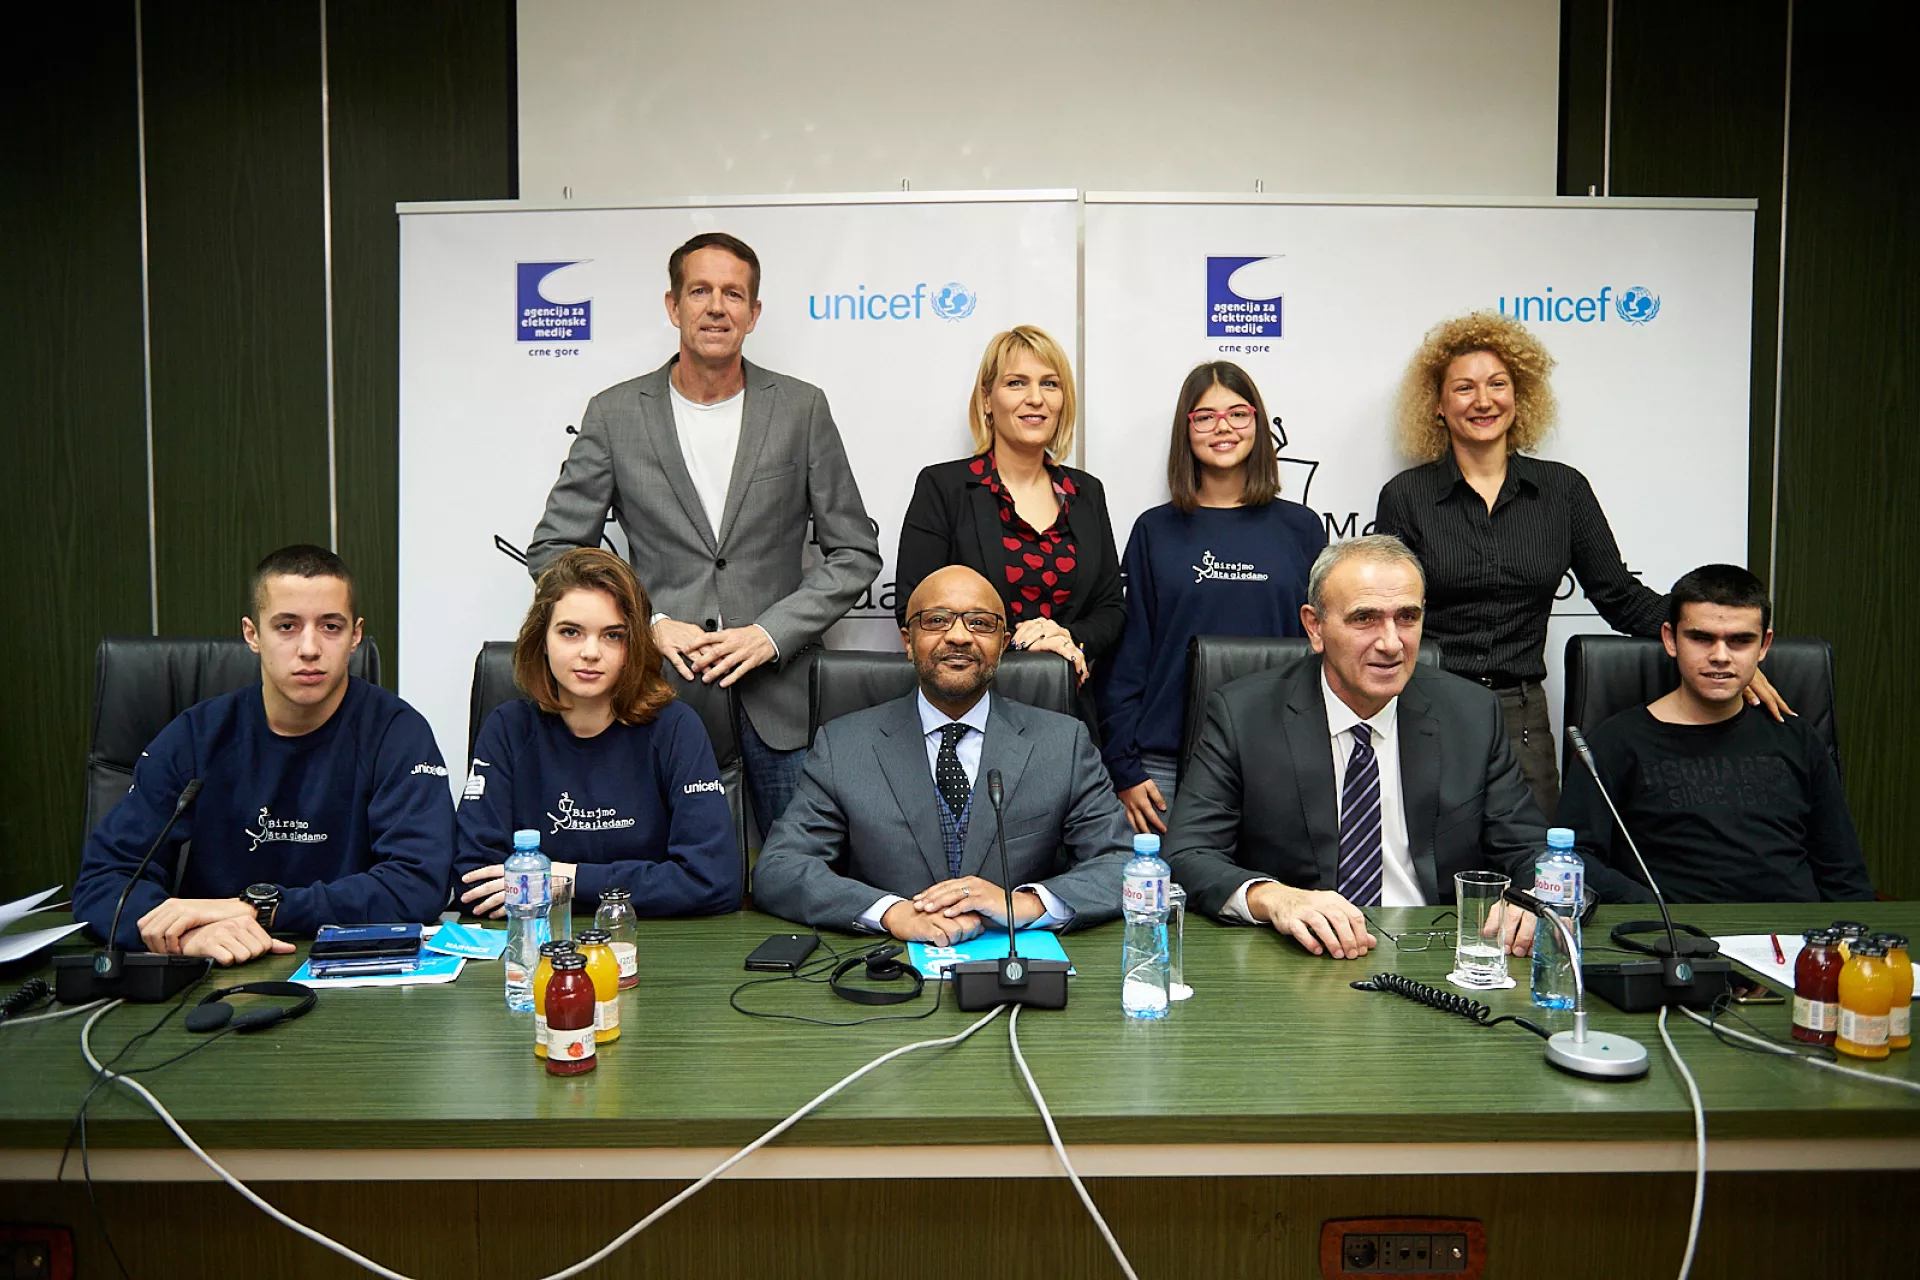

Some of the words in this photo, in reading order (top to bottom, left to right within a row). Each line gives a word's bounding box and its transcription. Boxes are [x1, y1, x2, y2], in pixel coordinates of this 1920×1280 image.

[809, 283, 927, 320] unicef
[1498, 286, 1612, 322] unicef
[523, 305, 570, 318] agencija
[571, 307, 585, 316] za
[1213, 302, 1261, 314] agencija
[1262, 303, 1276, 312] za
[521, 316, 587, 328] elektronske
[1211, 313, 1278, 323] elektronske
[534, 327, 573, 339] medije
[1224, 323, 1263, 335] medije
[528, 348, 551, 357] crne
[554, 348, 580, 358] gore
[1245, 345, 1271, 354] gore
[683, 779, 719, 794] unicef
